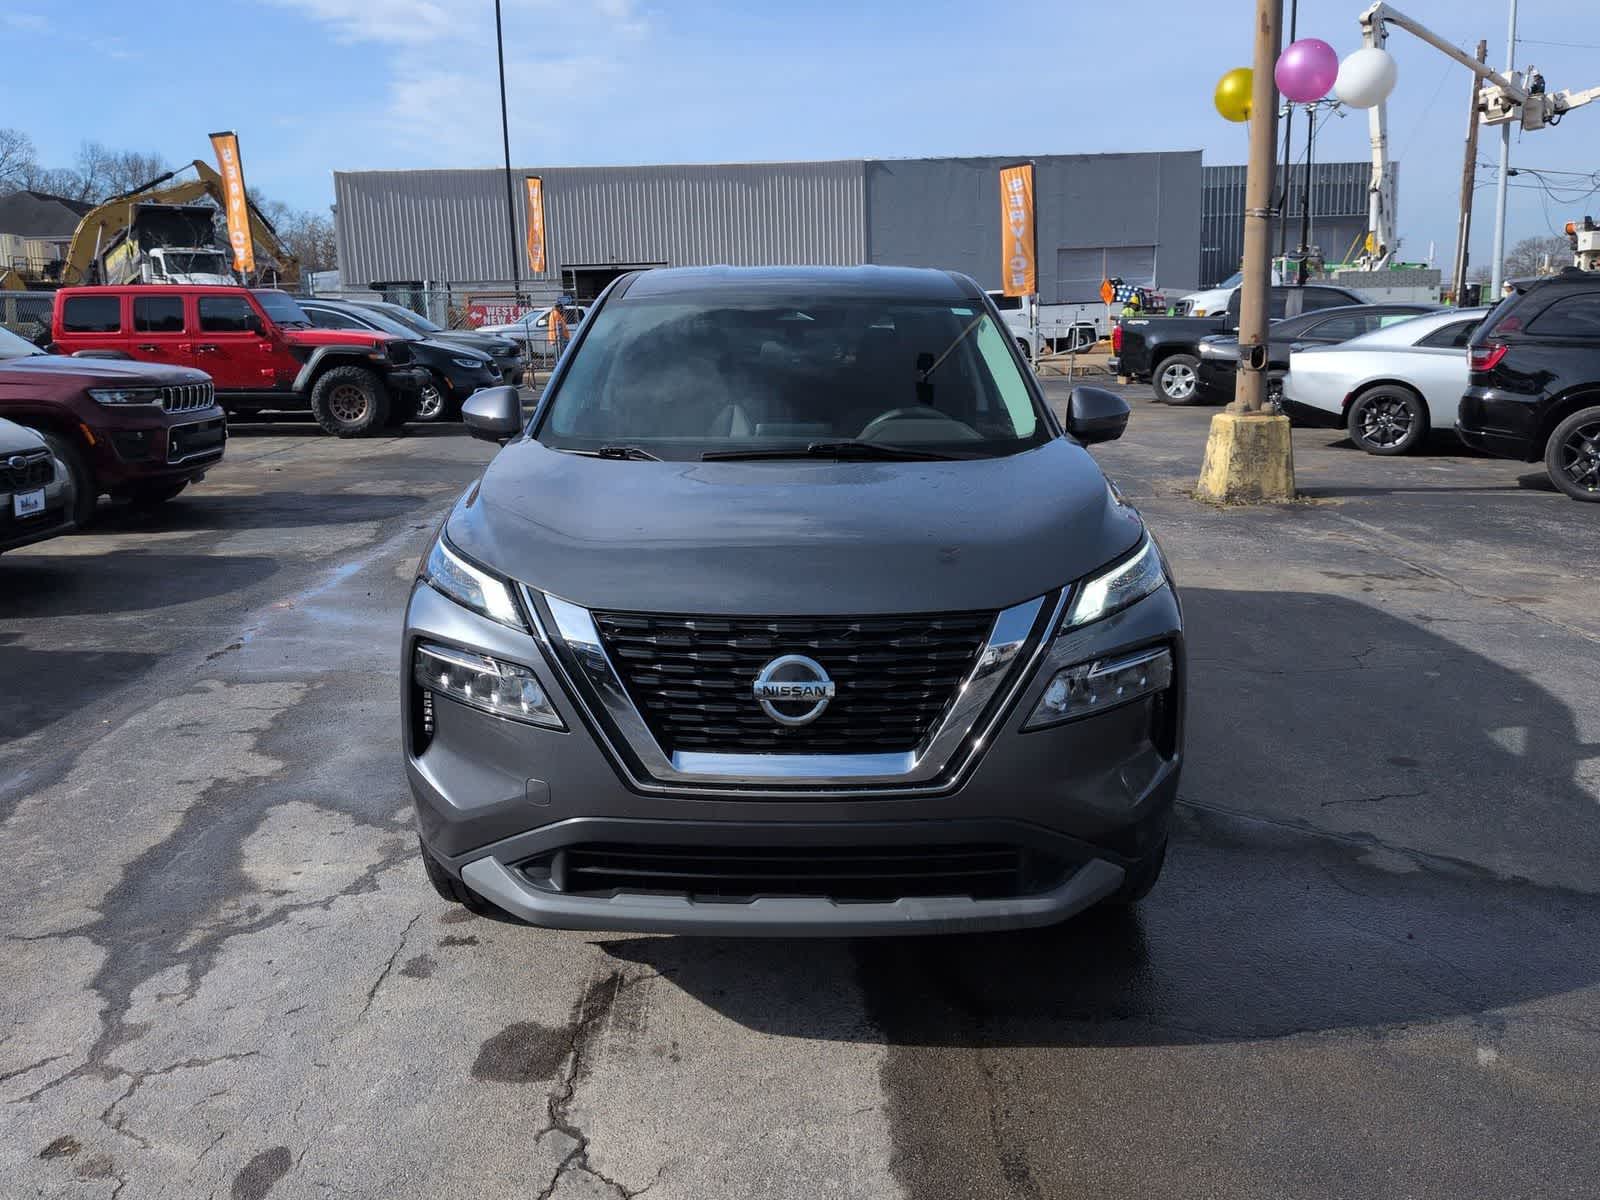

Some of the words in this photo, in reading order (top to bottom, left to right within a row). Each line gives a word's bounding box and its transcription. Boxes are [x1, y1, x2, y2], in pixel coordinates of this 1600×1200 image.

[486, 306, 514, 316] WEST
[483, 315, 506, 326] NEW
[762, 686, 826, 697] NISSAN
